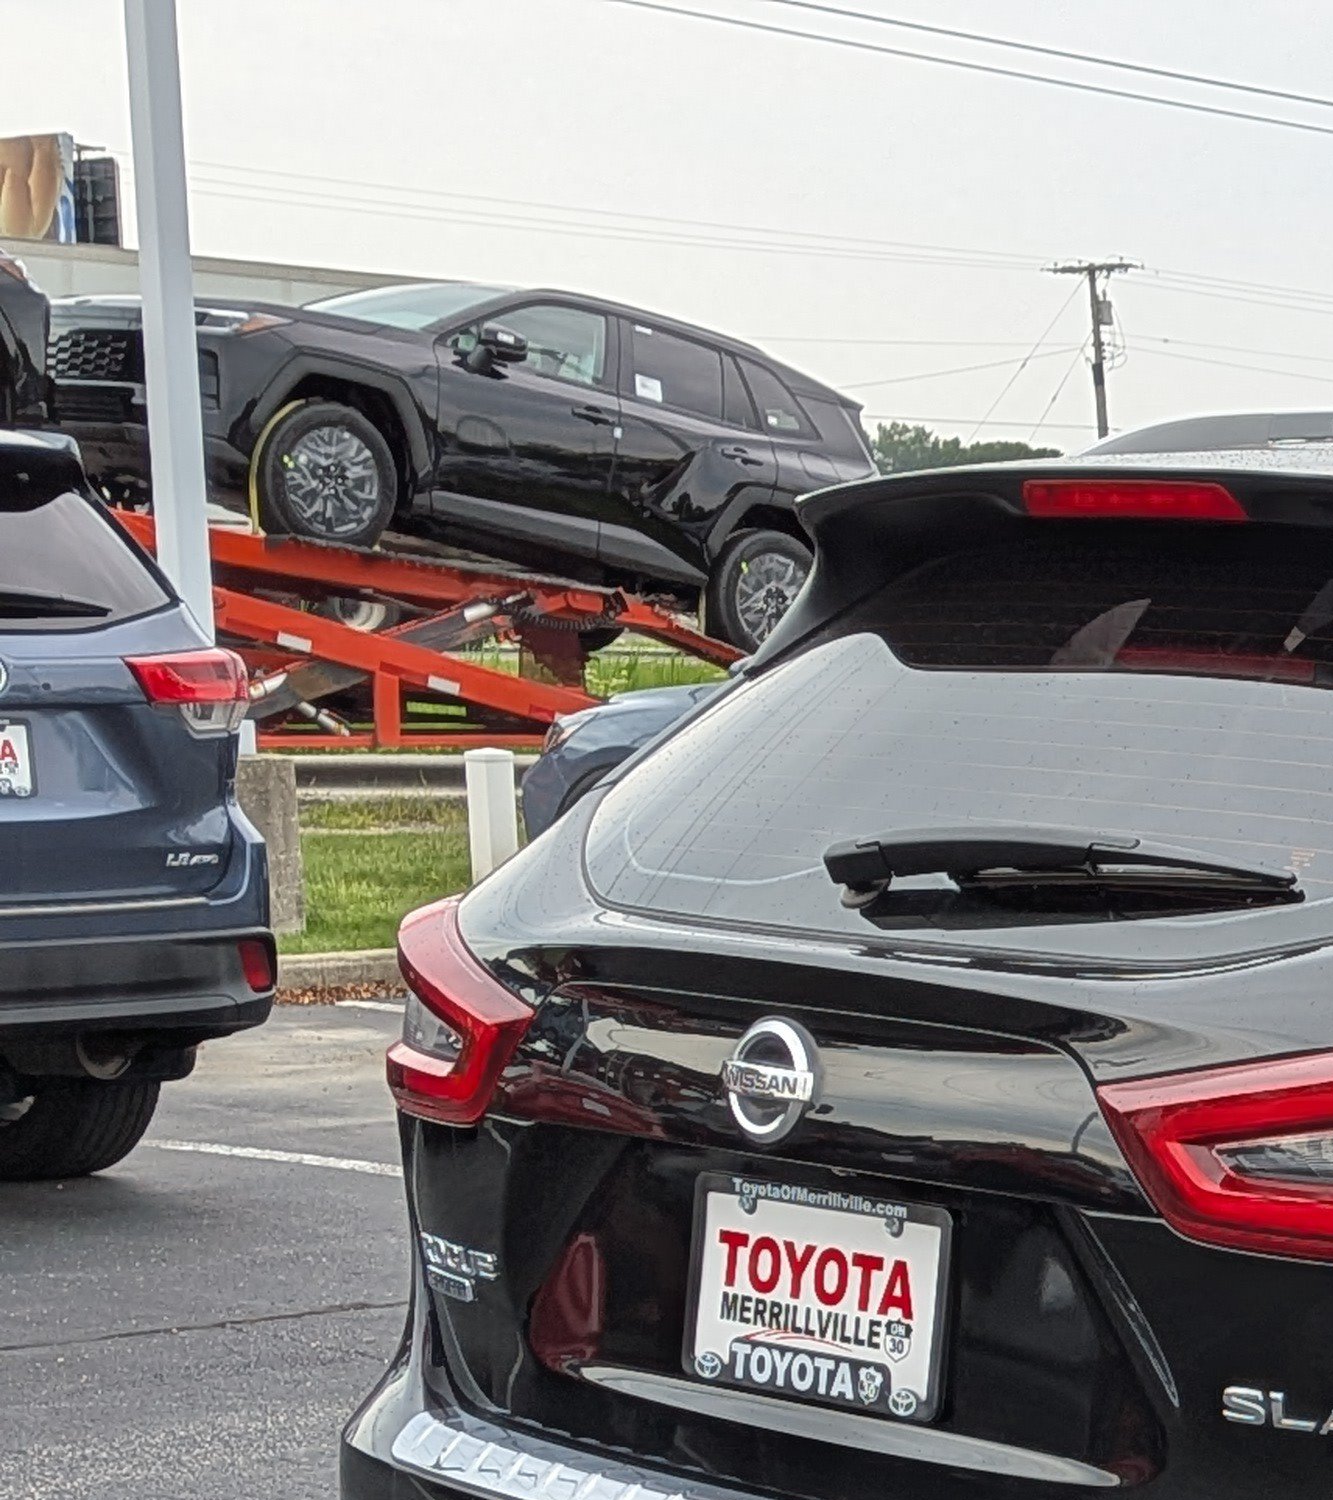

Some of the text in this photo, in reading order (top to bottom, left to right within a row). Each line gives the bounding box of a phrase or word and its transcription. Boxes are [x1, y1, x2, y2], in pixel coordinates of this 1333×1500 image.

[727, 1063, 798, 1096] NISSAN
[731, 1176, 908, 1219] ToyotaOfMerrillville.com
[718, 1227, 914, 1321] TOYOTA
[719, 1290, 882, 1350] MERRILLVILLE
[888, 1337, 905, 1355] 30
[730, 1341, 856, 1401] TOYOTA
[1221, 1385, 1318, 1433] SL
